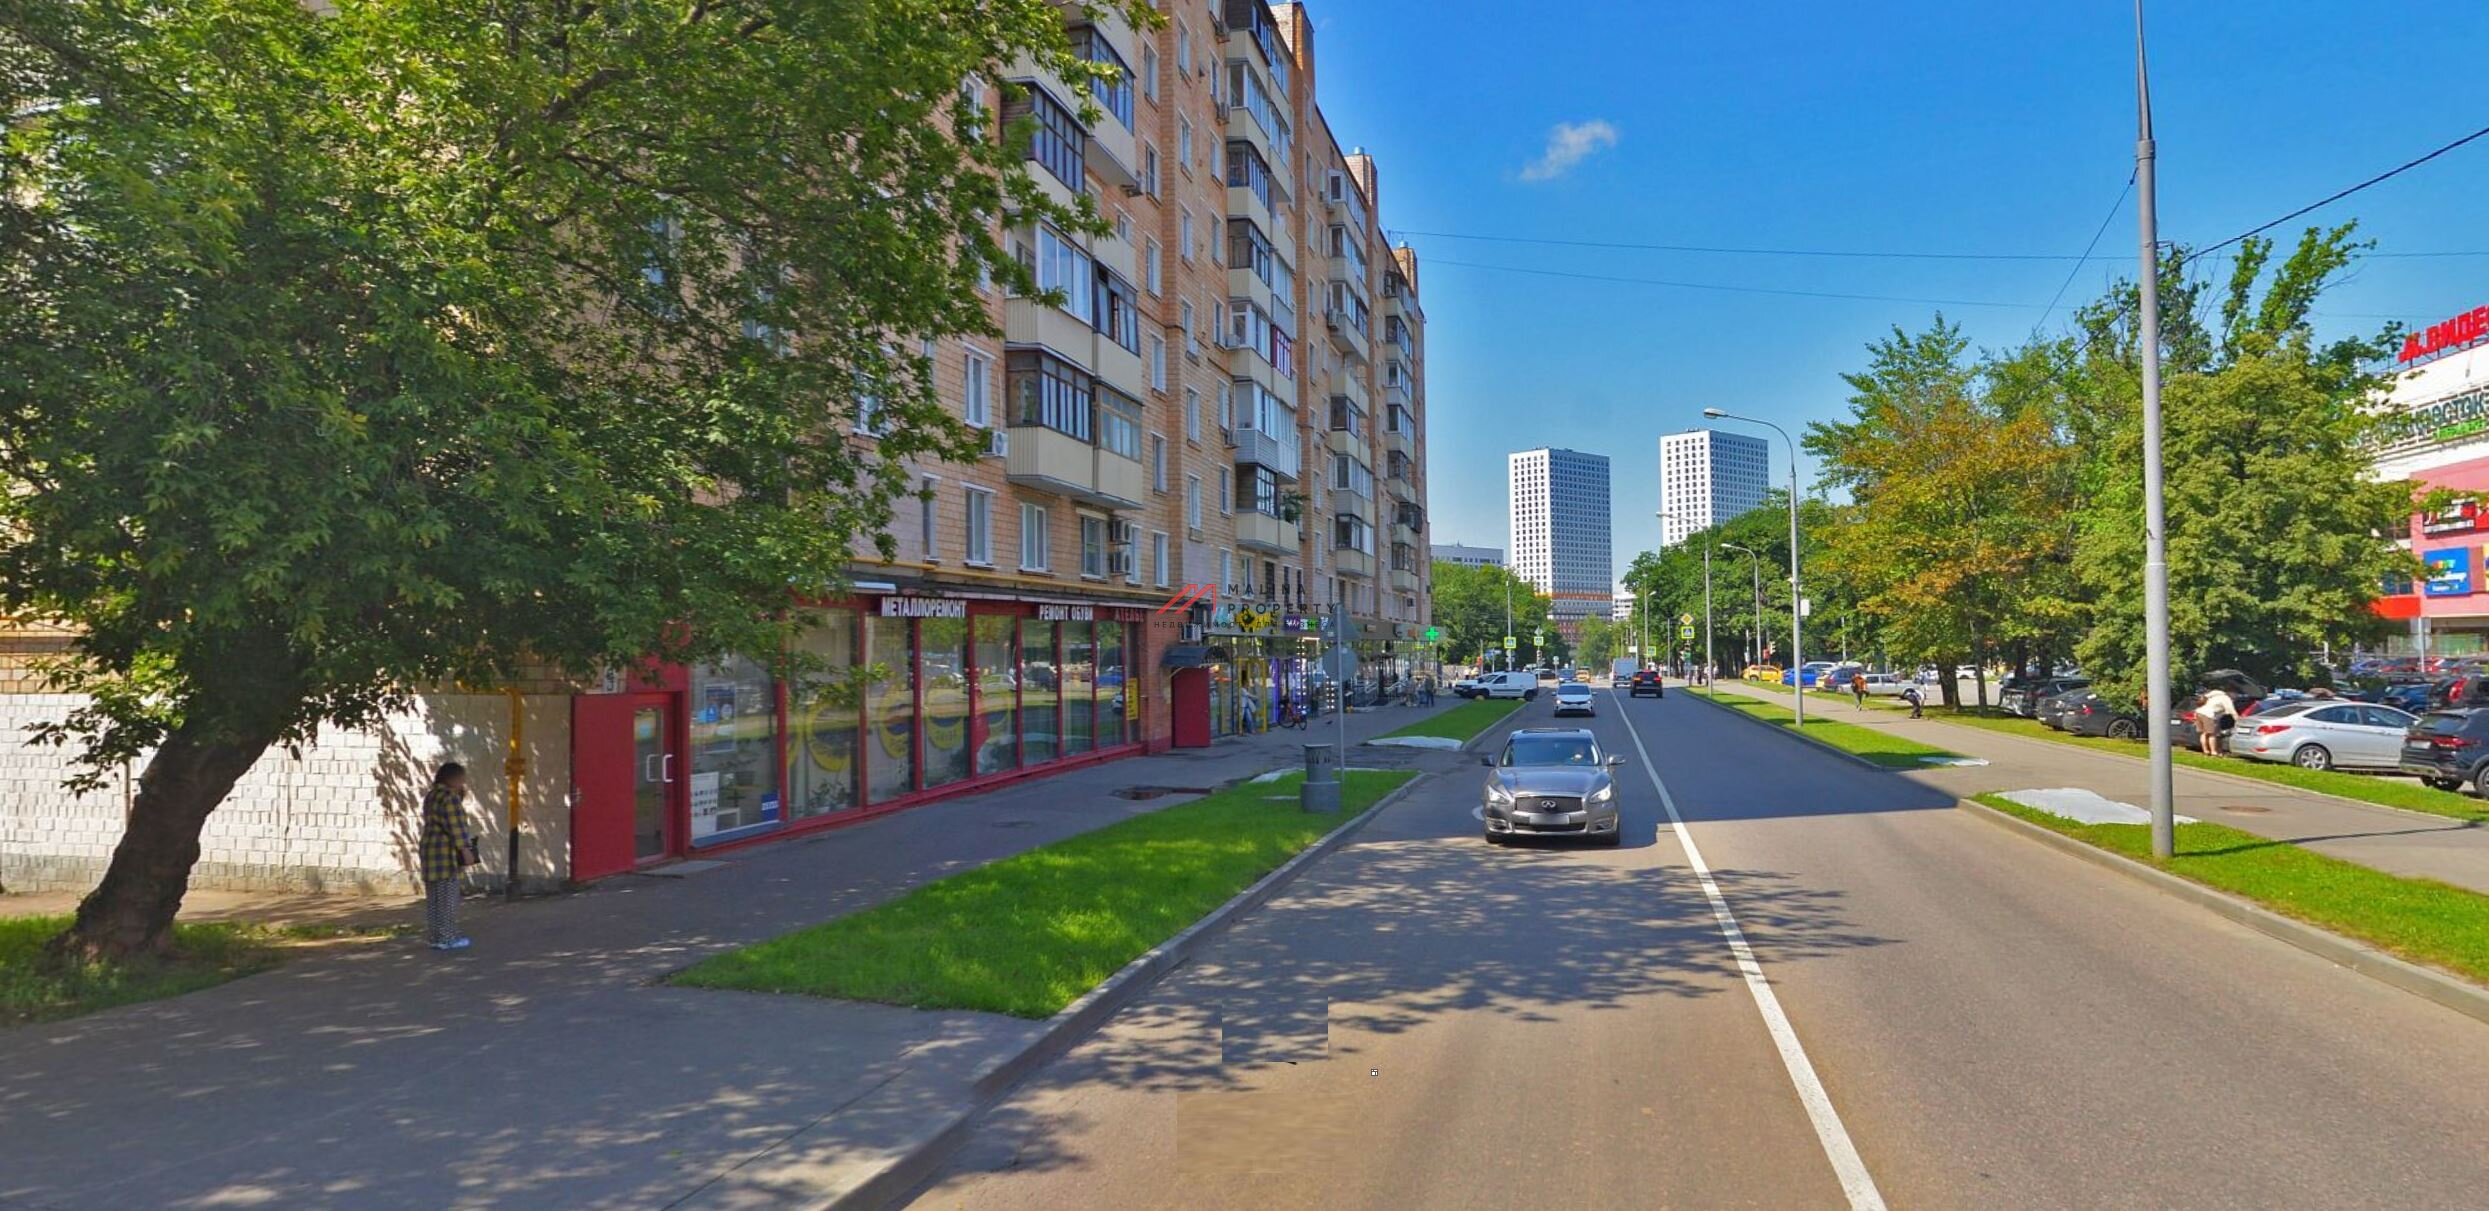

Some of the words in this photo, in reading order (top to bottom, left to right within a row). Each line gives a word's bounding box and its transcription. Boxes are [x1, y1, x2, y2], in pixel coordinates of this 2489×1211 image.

[881, 596, 967, 618] МЕТАЛЛОРЕМОНТ
[1039, 604, 1069, 621] РЕМОНТ
[1071, 605, 1094, 621] ОБУВИ
